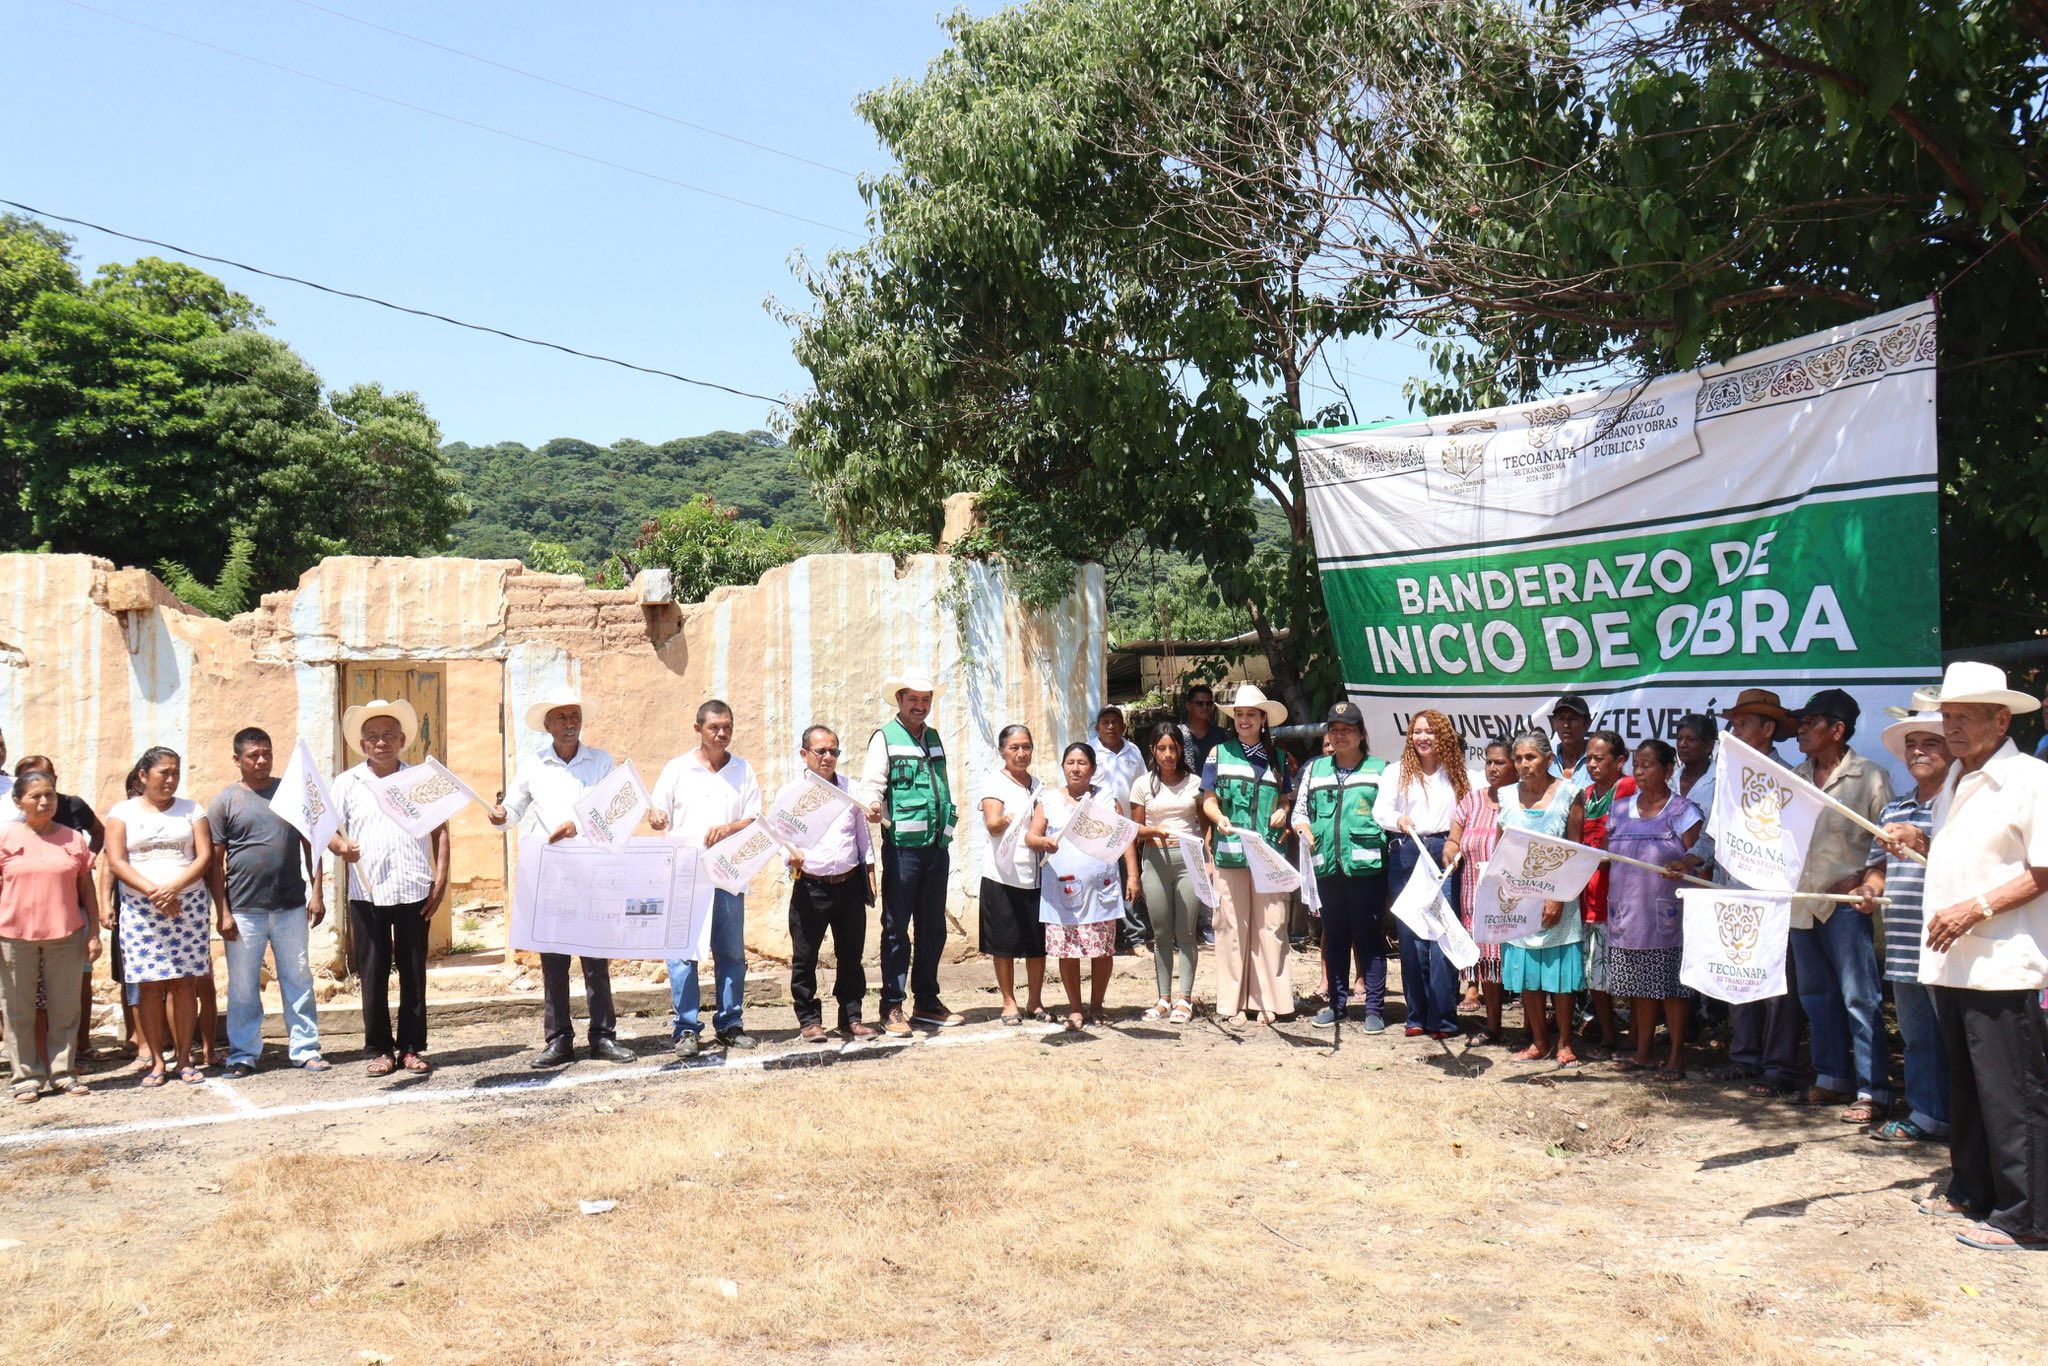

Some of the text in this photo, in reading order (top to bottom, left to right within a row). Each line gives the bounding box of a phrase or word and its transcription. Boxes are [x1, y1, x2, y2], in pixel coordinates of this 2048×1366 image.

[1637, 423, 1644, 434] Y
[1644, 416, 1678, 433] OBRAS
[1503, 446, 1577, 470] TECOANAPA
[1594, 438, 1645, 458] PÚBLICAS
[1396, 530, 1777, 615] BANDERAZO DE
[1365, 584, 1858, 675] INICIO DE OBRA
[1502, 869, 1556, 893] TECOANAPA
[1484, 914, 1527, 924] TECOANAPA
[1708, 962, 1767, 979] TECOANAPA
